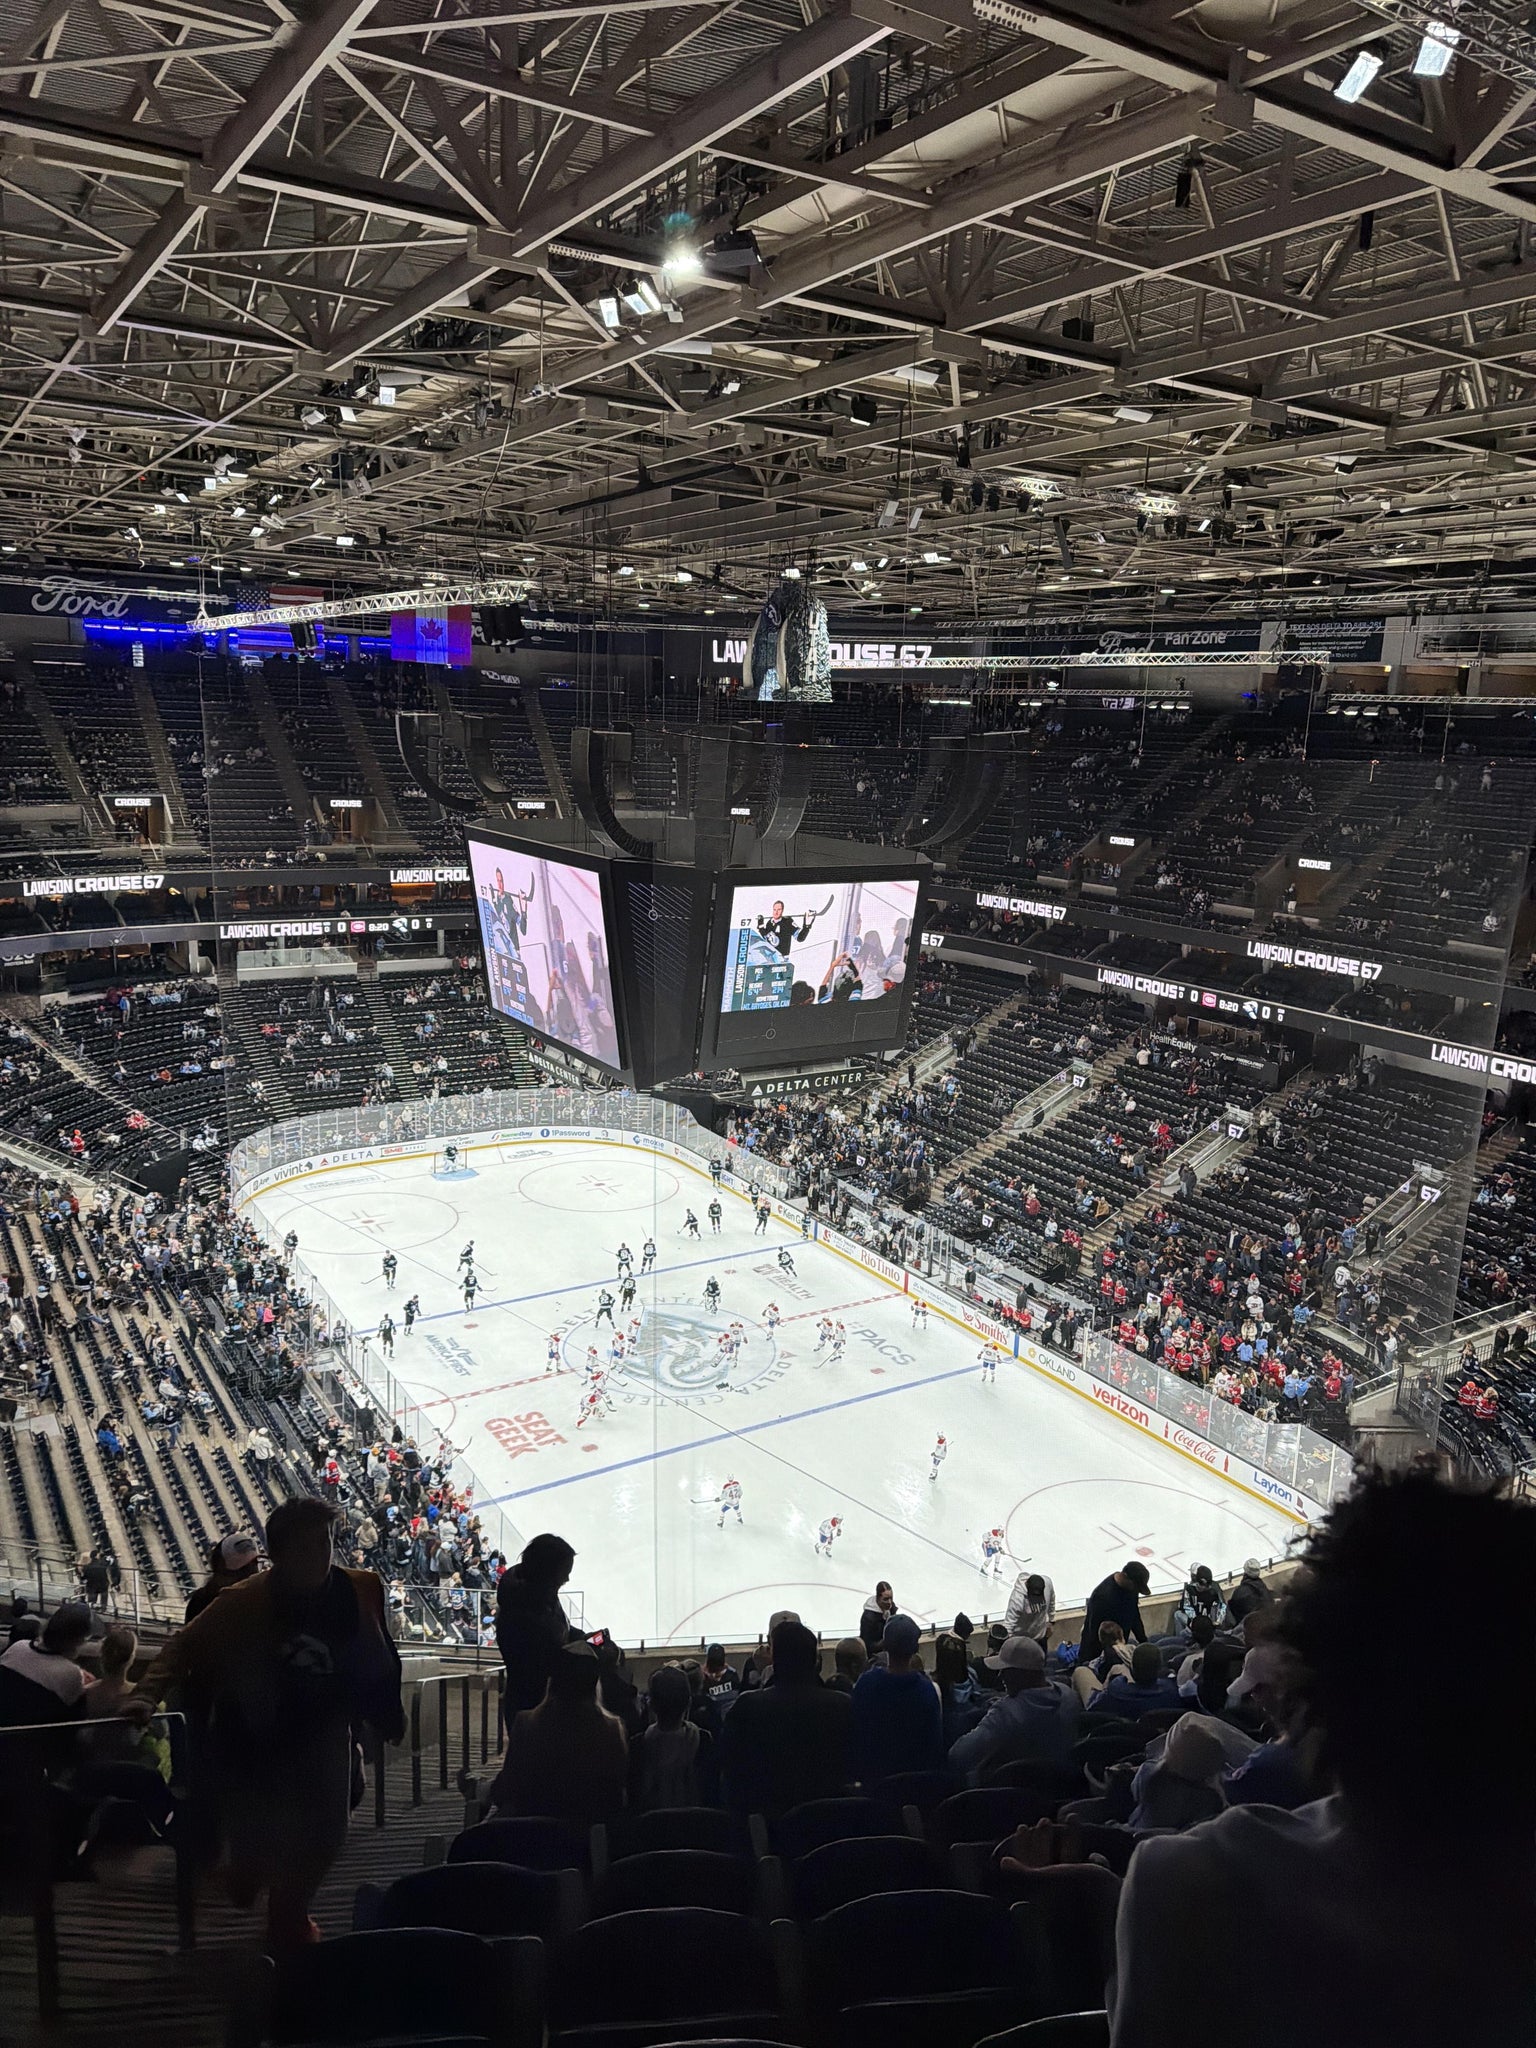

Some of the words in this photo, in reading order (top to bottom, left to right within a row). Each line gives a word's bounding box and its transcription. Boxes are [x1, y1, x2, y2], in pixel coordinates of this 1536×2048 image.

[31, 575, 130, 618] Ford
[1192, 631, 1227, 645] Zone
[713, 640, 747, 663] LAW
[900, 645, 932, 667] 67
[114, 798, 152, 807] CROUSE
[330, 800, 362, 808] CROUSE
[1109, 836, 1135, 847] CROUSE
[390, 870, 433, 883] LAWSON
[1298, 858, 1332, 871] CROUSE
[23, 879, 74, 897] LAWSON
[75, 876, 143, 893] CROUSE
[143, 875, 165, 889] 67
[977, 893, 1009, 911] LAWSON
[1010, 898, 1053, 918] CROUSE
[1053, 907, 1067, 921] 67
[220, 923, 271, 939] LAWSON
[930, 935, 944, 947] 67
[738, 929, 749, 963] CROUSE
[1247, 941, 1293, 964] LAWSON
[1294, 949, 1361, 977] CROUSE
[1361, 961, 1383, 980] 67
[735, 964, 745, 993] LAWSON
[1097, 968, 1134, 990] LAWSON
[1218, 999, 1239, 1013] 8:20
[1149, 1031, 1198, 1053] HealthEquity
[534, 1053, 555, 1073] DELTA
[555, 1066, 580, 1087] CENTER
[1431, 1044, 1488, 1072] LAWSON
[766, 1080, 810, 1095] DELTA
[814, 1072, 863, 1088] CENTER
[551, 1129, 591, 1138] 1Password
[332, 1150, 374, 1164] DELTA
[273, 1163, 305, 1182] vivint
[773, 1275, 816, 1300] HEALTH
[974, 1315, 1008, 1346] Smith's
[424, 1334, 452, 1363] AMERICA
[851, 1328, 917, 1366] PACS
[1038, 1353, 1076, 1382] OKLAND
[1092, 1383, 1149, 1428] verizon
[484, 1418, 540, 1460] GEEK
[513, 1411, 568, 1447] SEAT
[1253, 1471, 1292, 1502] Layton
[708, 1681, 733, 1696] COOLEY
